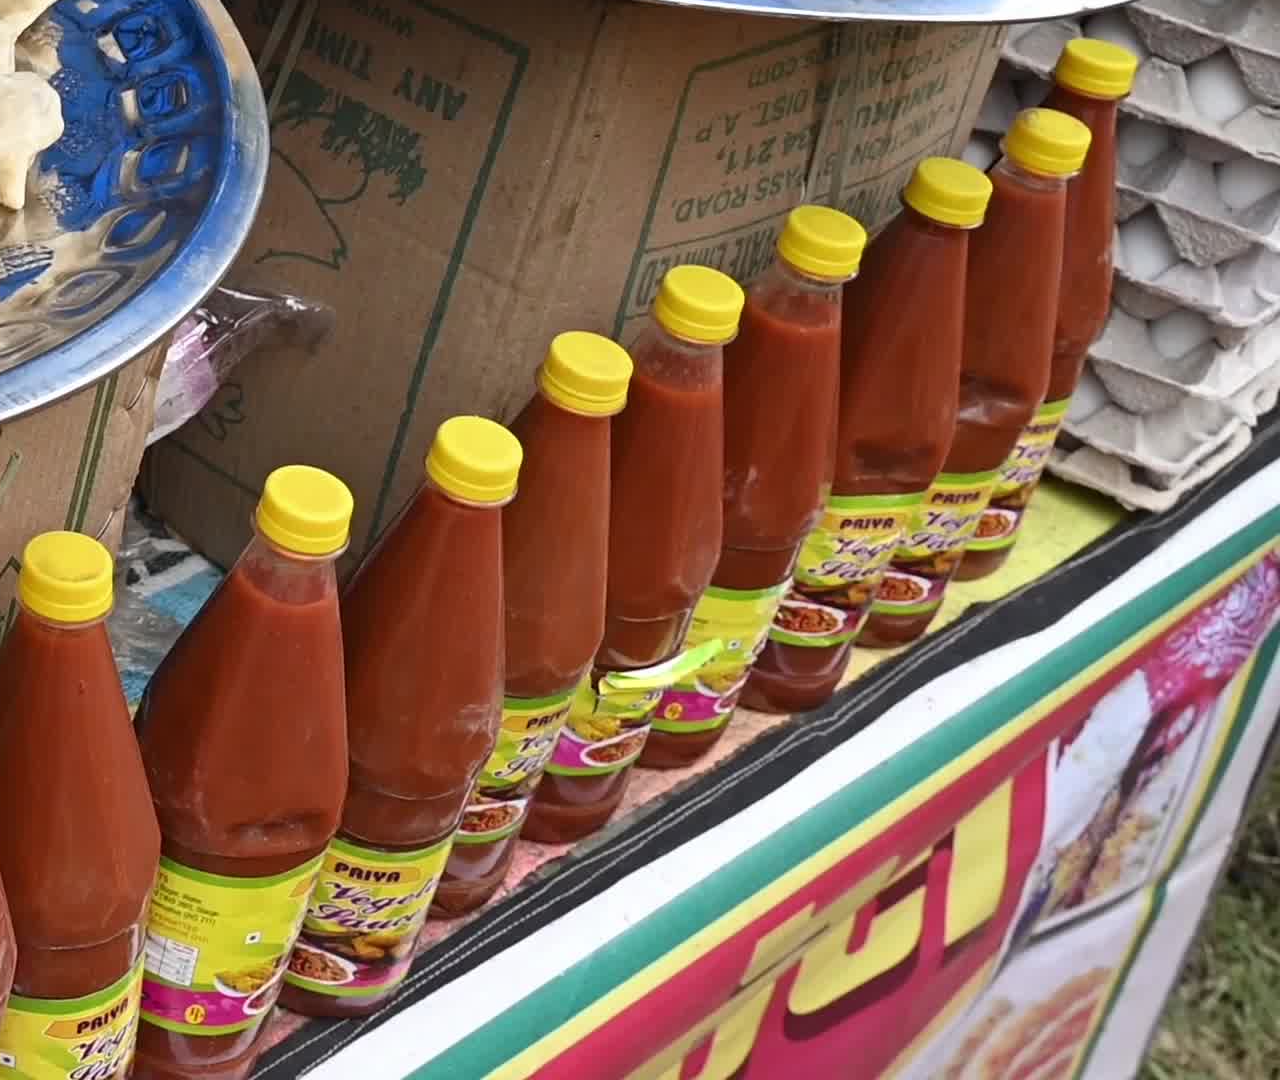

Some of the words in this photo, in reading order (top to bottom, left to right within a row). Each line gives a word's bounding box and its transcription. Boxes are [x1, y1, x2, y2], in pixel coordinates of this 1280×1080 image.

[304, 18, 372, 83] TIM
[393, 67, 468, 120] ANY
[671, 188, 750, 223] ROAD,
[930, 491, 982, 504] PRIYA
[840, 517, 896, 530] PRIYA
[334, 861, 401, 883] PRIYA
[76, 997, 129, 1035] PRIYA
